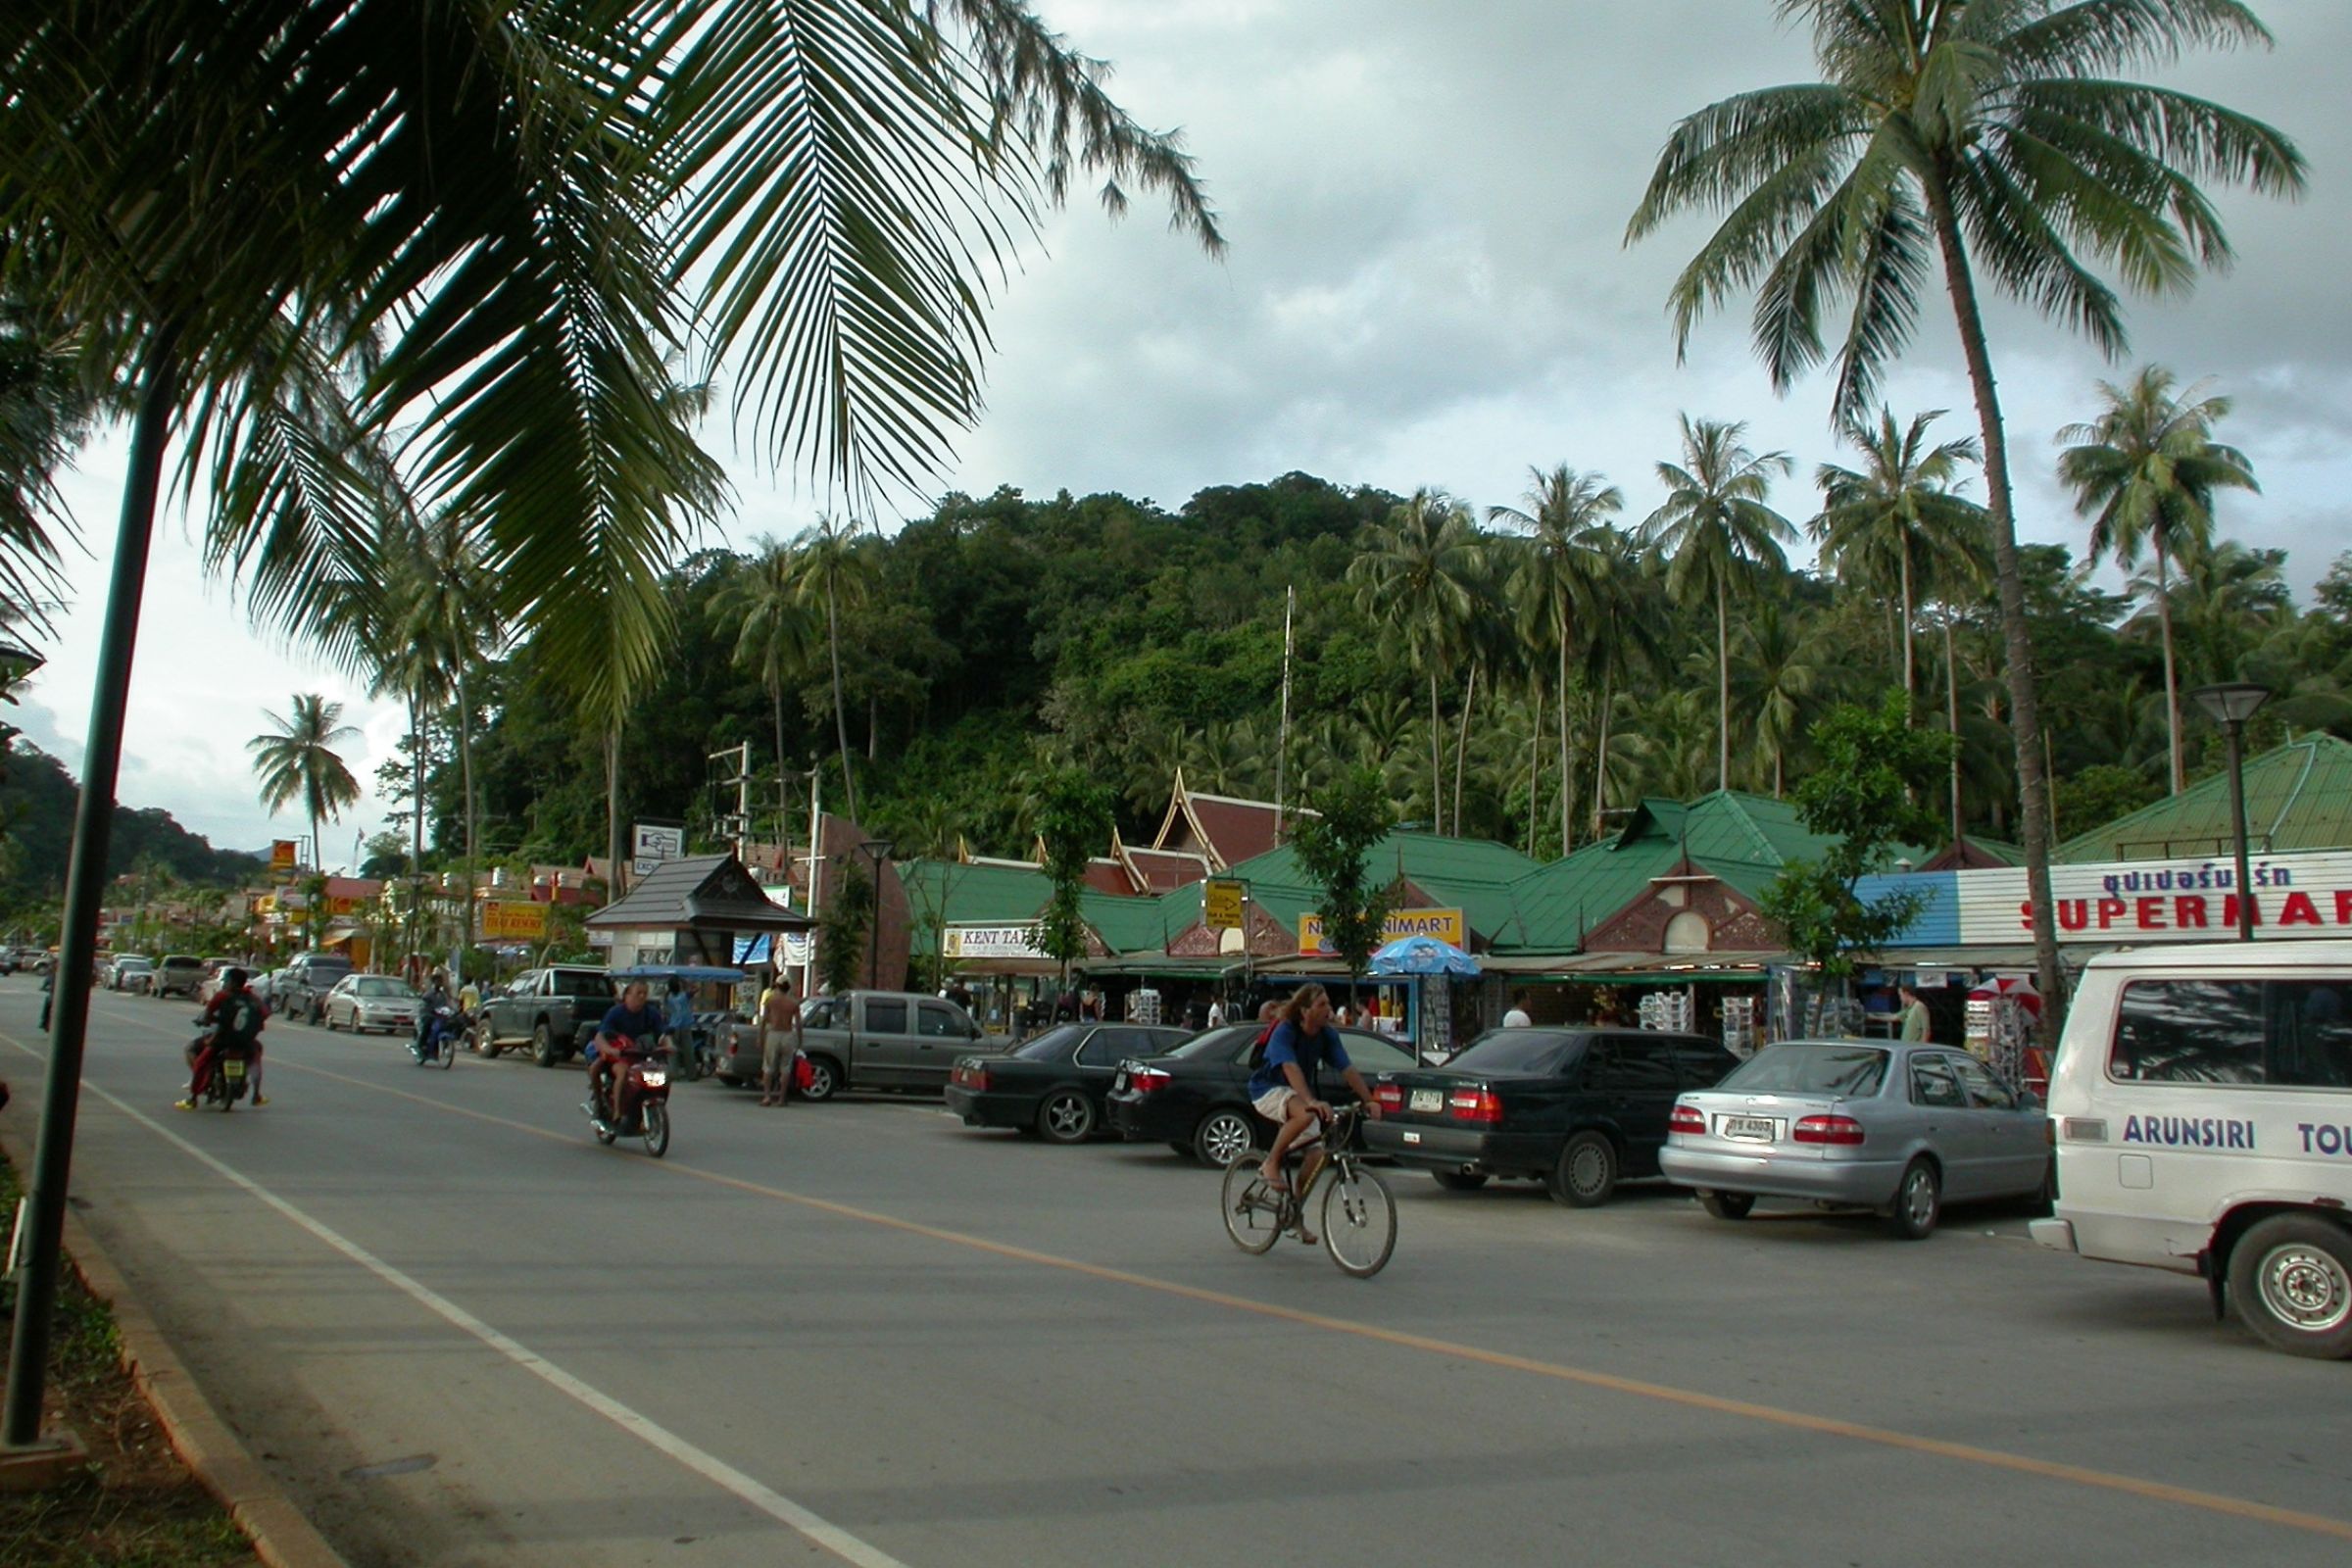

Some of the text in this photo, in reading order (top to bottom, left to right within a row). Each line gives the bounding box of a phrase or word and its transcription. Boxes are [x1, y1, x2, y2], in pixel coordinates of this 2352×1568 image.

[1383, 916, 1453, 934] NIMART
[964, 930, 1000, 945] KENT
[2123, 1114, 2255, 1150] ARUNSIRI
